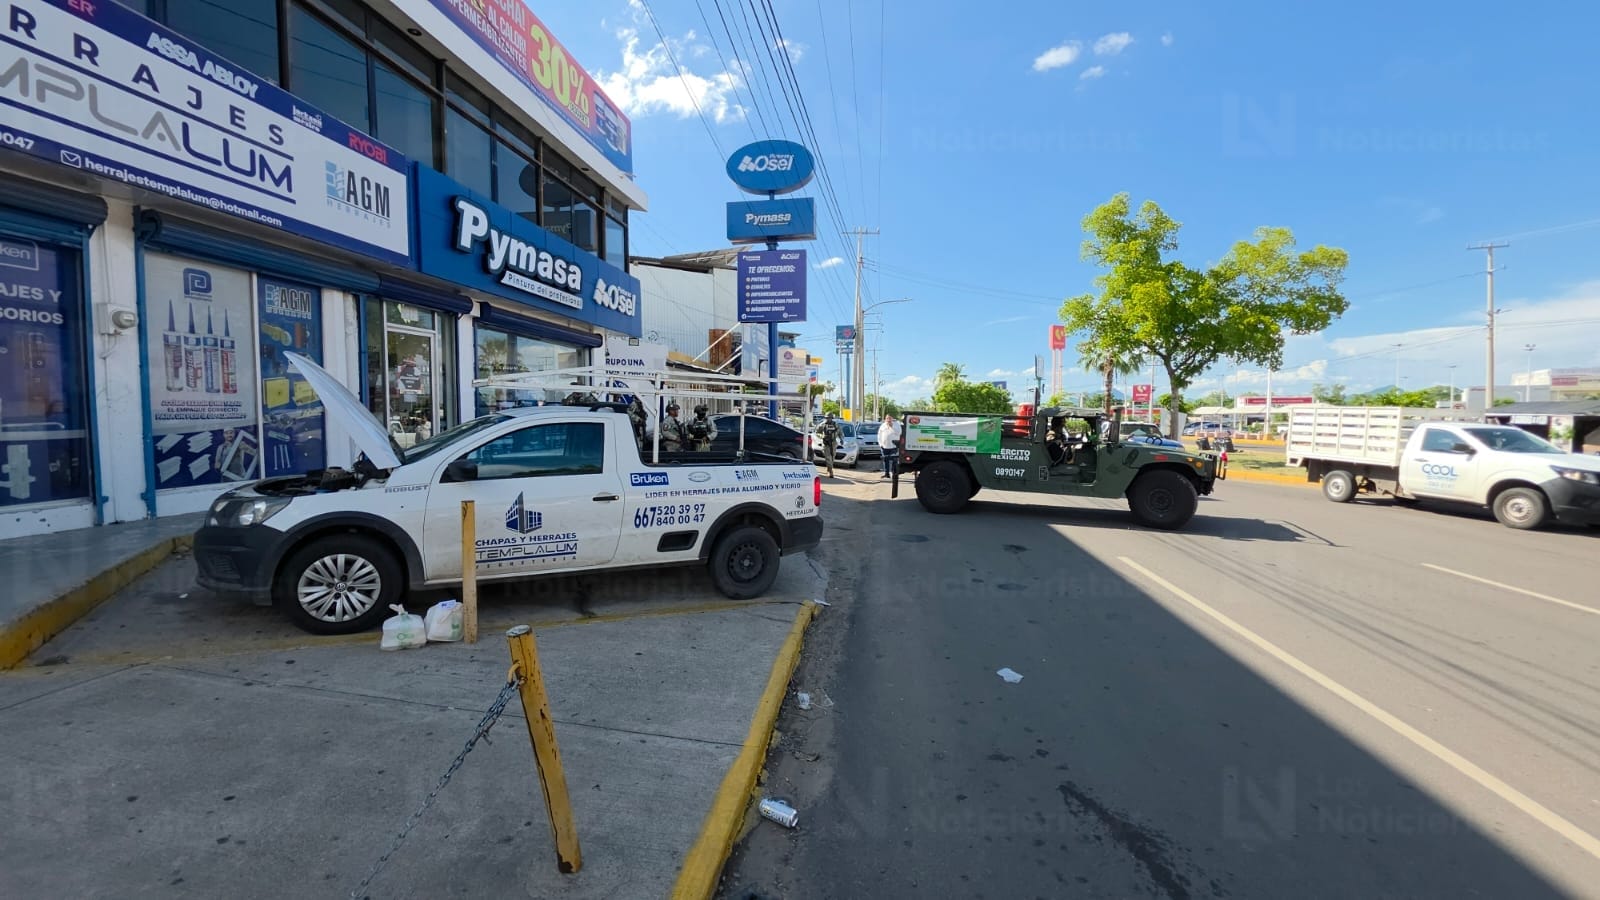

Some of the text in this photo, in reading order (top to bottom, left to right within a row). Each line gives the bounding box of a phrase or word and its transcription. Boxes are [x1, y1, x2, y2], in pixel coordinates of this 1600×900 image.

[447, 0, 527, 71] PERMEABILIZANTES
[147, 31, 259, 99] ASSA ABLOY
[530, 24, 589, 115] 30%
[0, 131, 34, 150] 047
[348, 131, 388, 165] RYOBI
[84, 157, 283, 228] herrajestemplalum@hotmail.com
[346, 170, 391, 218] AGM
[745, 213, 792, 225] Pymasa
[457, 199, 582, 292] Pymasa
[757, 264, 796, 274] OFRECEMOS:
[48, 289, 62, 303] Y
[280, 286, 311, 313] AGM
[628, 359, 645, 367] UNA
[631, 473, 668, 485] Bruken
[1422, 463, 1458, 477] COOL
[634, 504, 706, 528] 667 520 39 97
[656, 514, 706, 526] 840 00 47
[475, 538, 516, 546] CHAPAS
[530, 532, 577, 542] HERRAJES
[475, 543, 578, 559] TEMPLALUM
